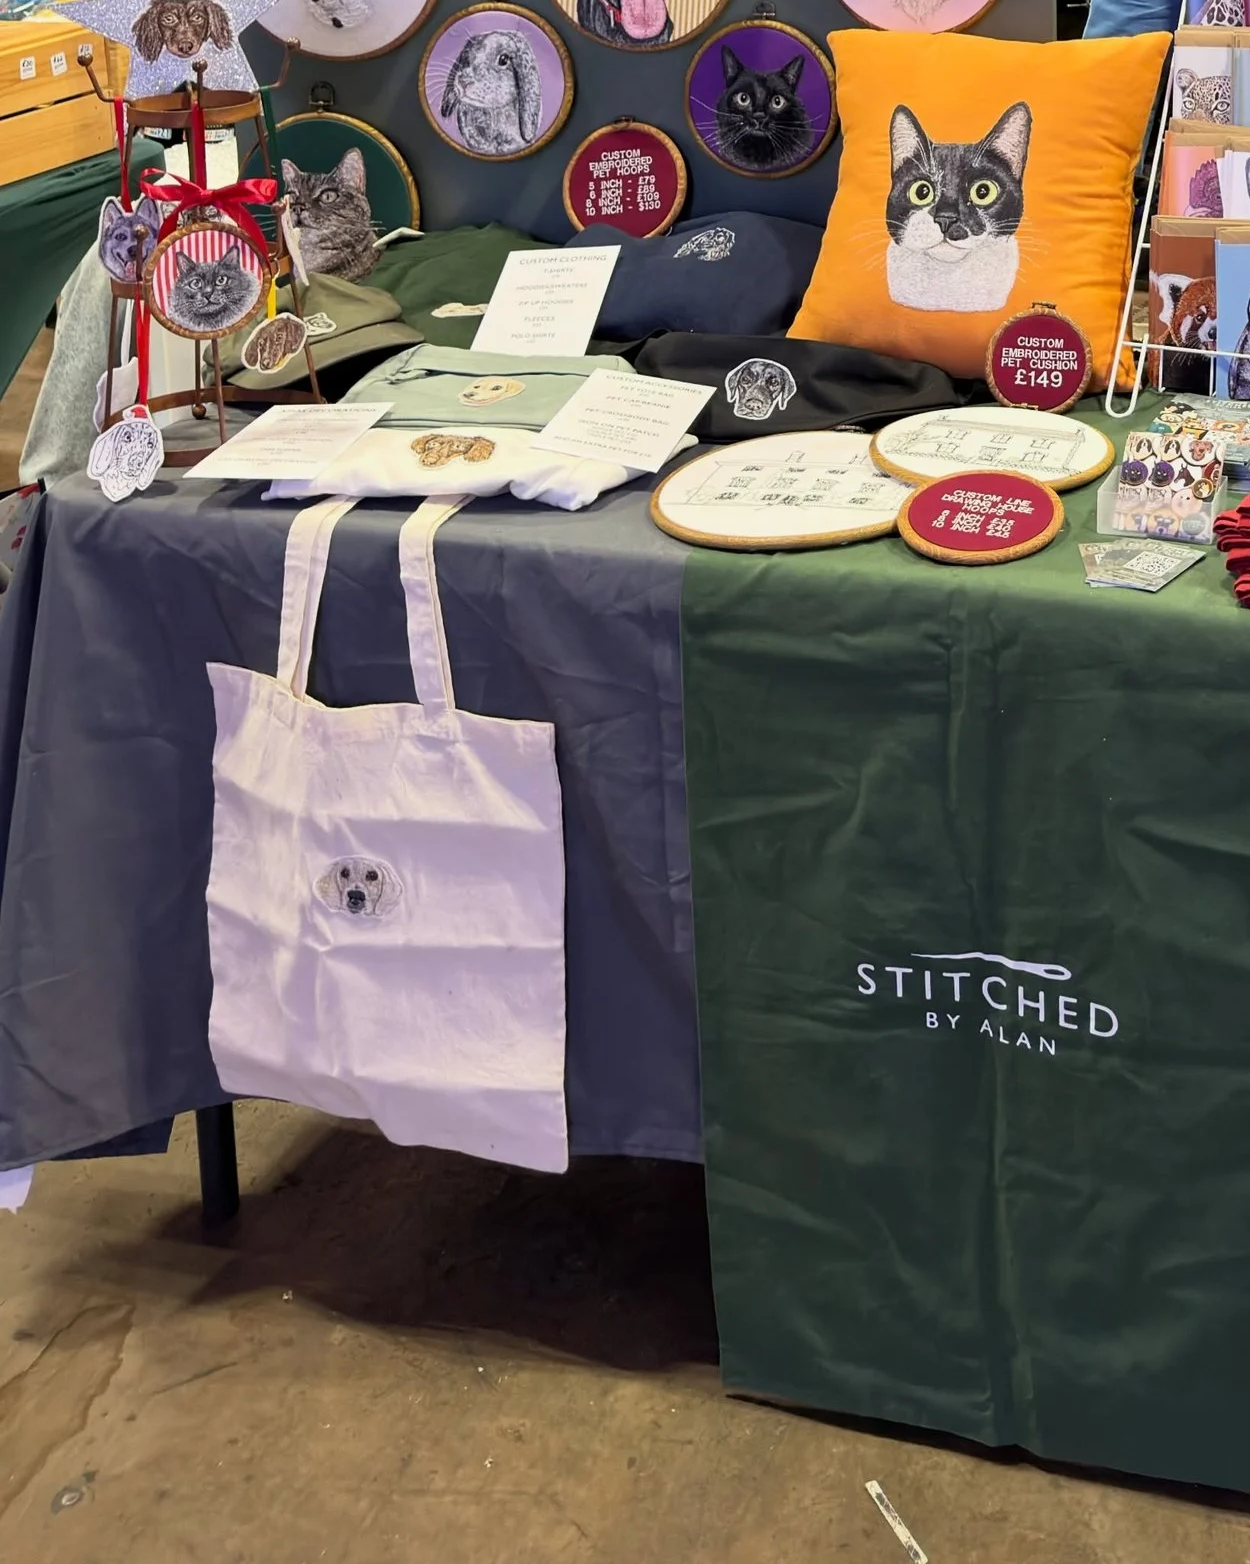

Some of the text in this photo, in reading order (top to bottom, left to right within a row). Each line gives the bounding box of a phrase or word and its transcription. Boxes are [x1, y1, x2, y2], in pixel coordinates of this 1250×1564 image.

[601, 149, 641, 161] CUSTOM
[589, 156, 653, 171] EMBROIDERED
[593, 165, 650, 179] PET HOOPS
[588, 181, 595, 190] 5
[600, 179, 623, 189] INCH
[638, 175, 656, 185] £79
[585, 199, 592, 208] 8
[598, 197, 621, 207] INCH
[637, 192, 660, 203] £109
[589, 191, 596, 199] 6
[601, 188, 623, 198] INCH
[585, 207, 596, 216] 10
[601, 205, 623, 216] INCH
[519, 254, 607, 265] CUSTOM CLOTHING
[1017, 336, 1064, 348] CUSTOM
[1002, 347, 1077, 360] EMBROIDERED
[1001, 358, 1078, 371] PET CUSHION
[1014, 369, 1063, 388] £149
[941, 494, 1035, 514] DRAWING HOUSE
[953, 489, 1033, 507] CUSTOM LINE
[962, 503, 1006, 516] HOOPS
[952, 518, 982, 528] INCH
[956, 512, 986, 522] INCH
[932, 520, 945, 528] 10
[950, 523, 980, 534] INCH
[857, 962, 1119, 1039] STITCHED
[926, 1012, 1057, 1056] BY ALAN
